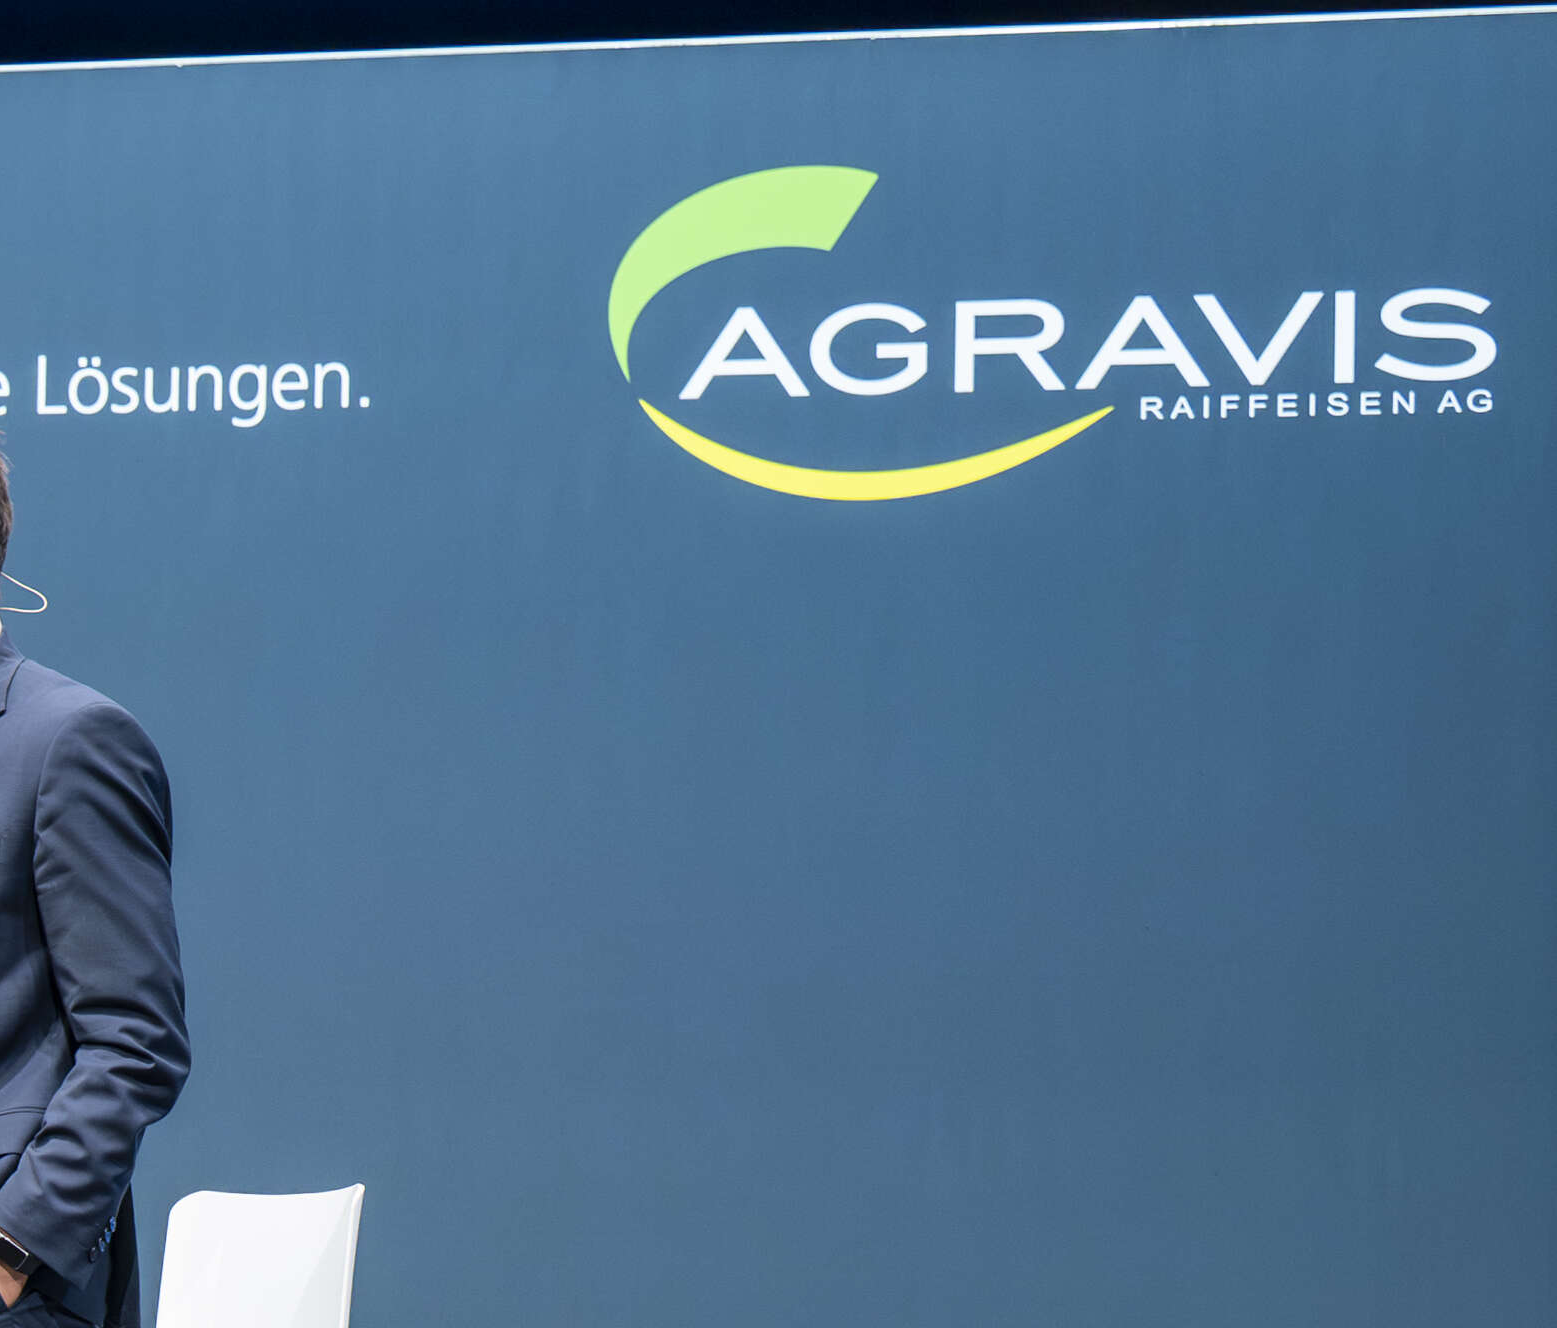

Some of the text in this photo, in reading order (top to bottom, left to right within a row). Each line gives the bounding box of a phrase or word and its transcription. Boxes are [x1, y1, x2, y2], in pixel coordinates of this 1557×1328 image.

[678, 288, 1498, 401] AGRAVIS
[36, 354, 371, 429] Lösungen.
[1139, 388, 1494, 421] RAIFFEISEN AG
